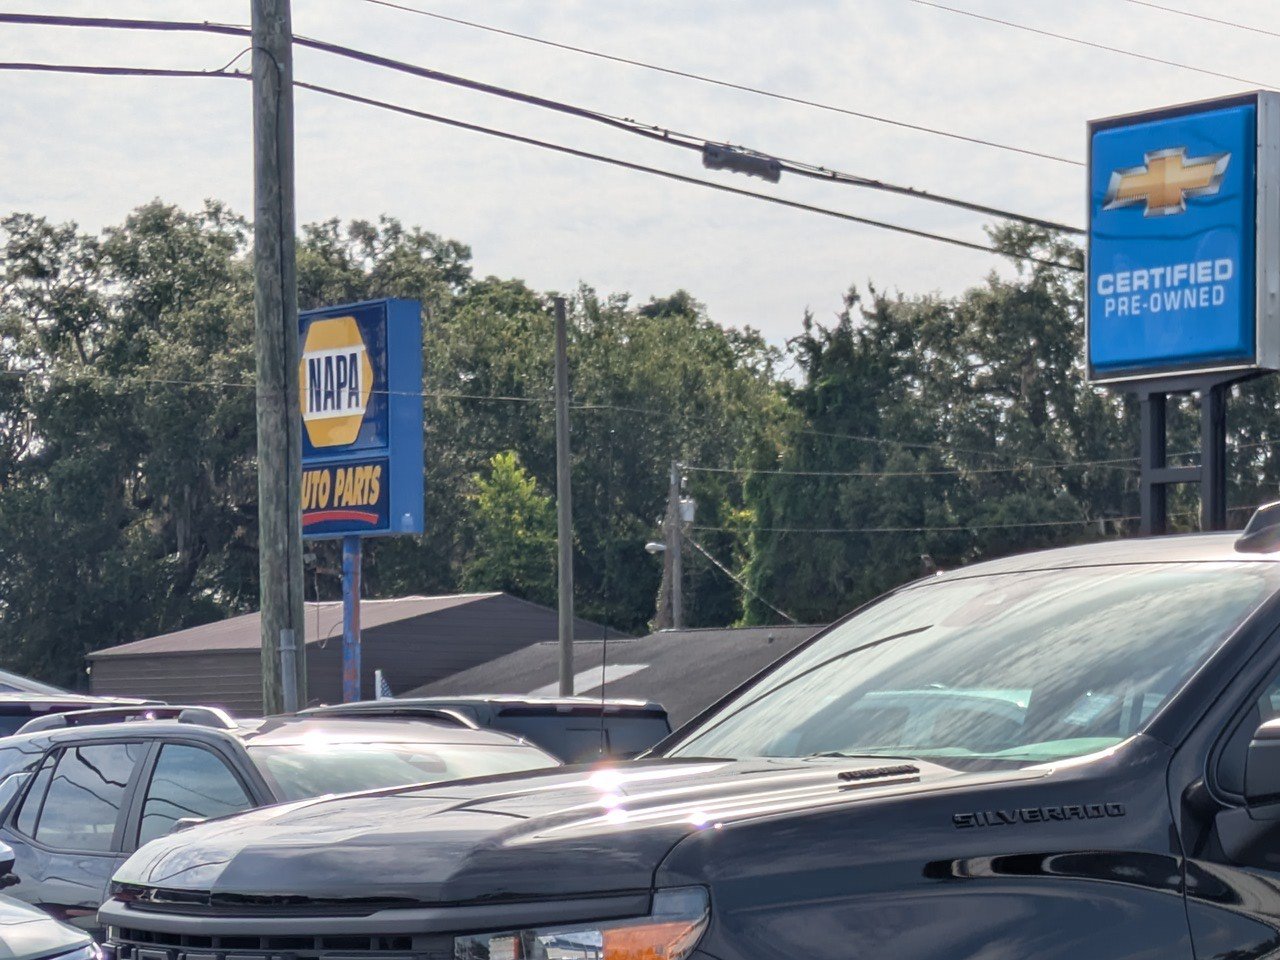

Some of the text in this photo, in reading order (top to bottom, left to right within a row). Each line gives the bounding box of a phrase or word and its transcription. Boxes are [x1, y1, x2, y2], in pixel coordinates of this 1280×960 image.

[1096, 258, 1234, 296] CERTIFIED
[1104, 285, 1225, 318] PRE-OWNED
[308, 352, 361, 413] NAPA
[301, 465, 382, 510] UTO PARTS
[952, 802, 1126, 829] SILVERADO
